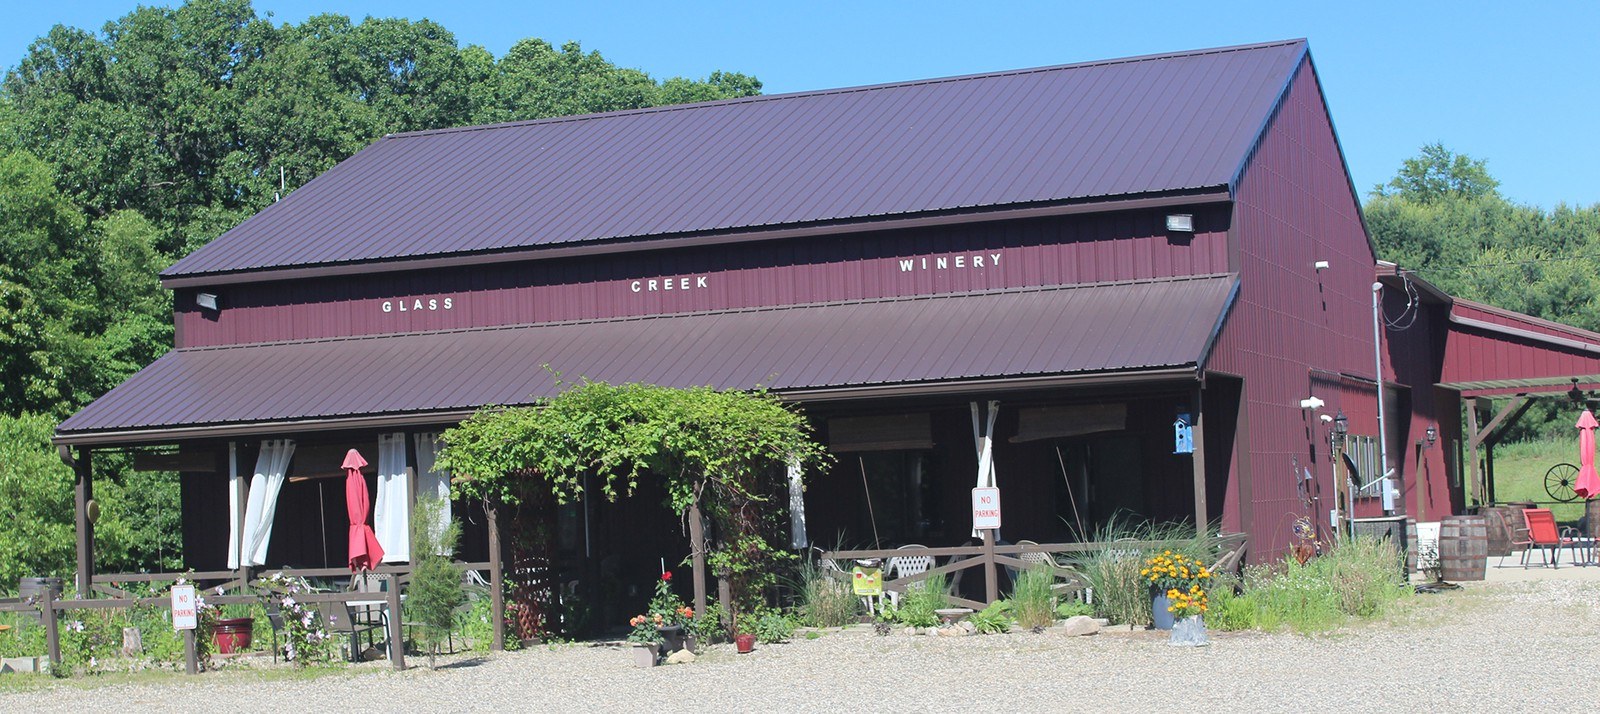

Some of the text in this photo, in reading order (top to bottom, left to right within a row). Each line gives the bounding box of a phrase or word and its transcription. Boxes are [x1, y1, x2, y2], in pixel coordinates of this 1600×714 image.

[382, 253, 1000, 312] GLASS CREEK WINERY
[981, 496, 991, 504] NO
[975, 509, 998, 518] PARKING
[179, 595, 188, 603] NO
[174, 609, 195, 618] PARKING
